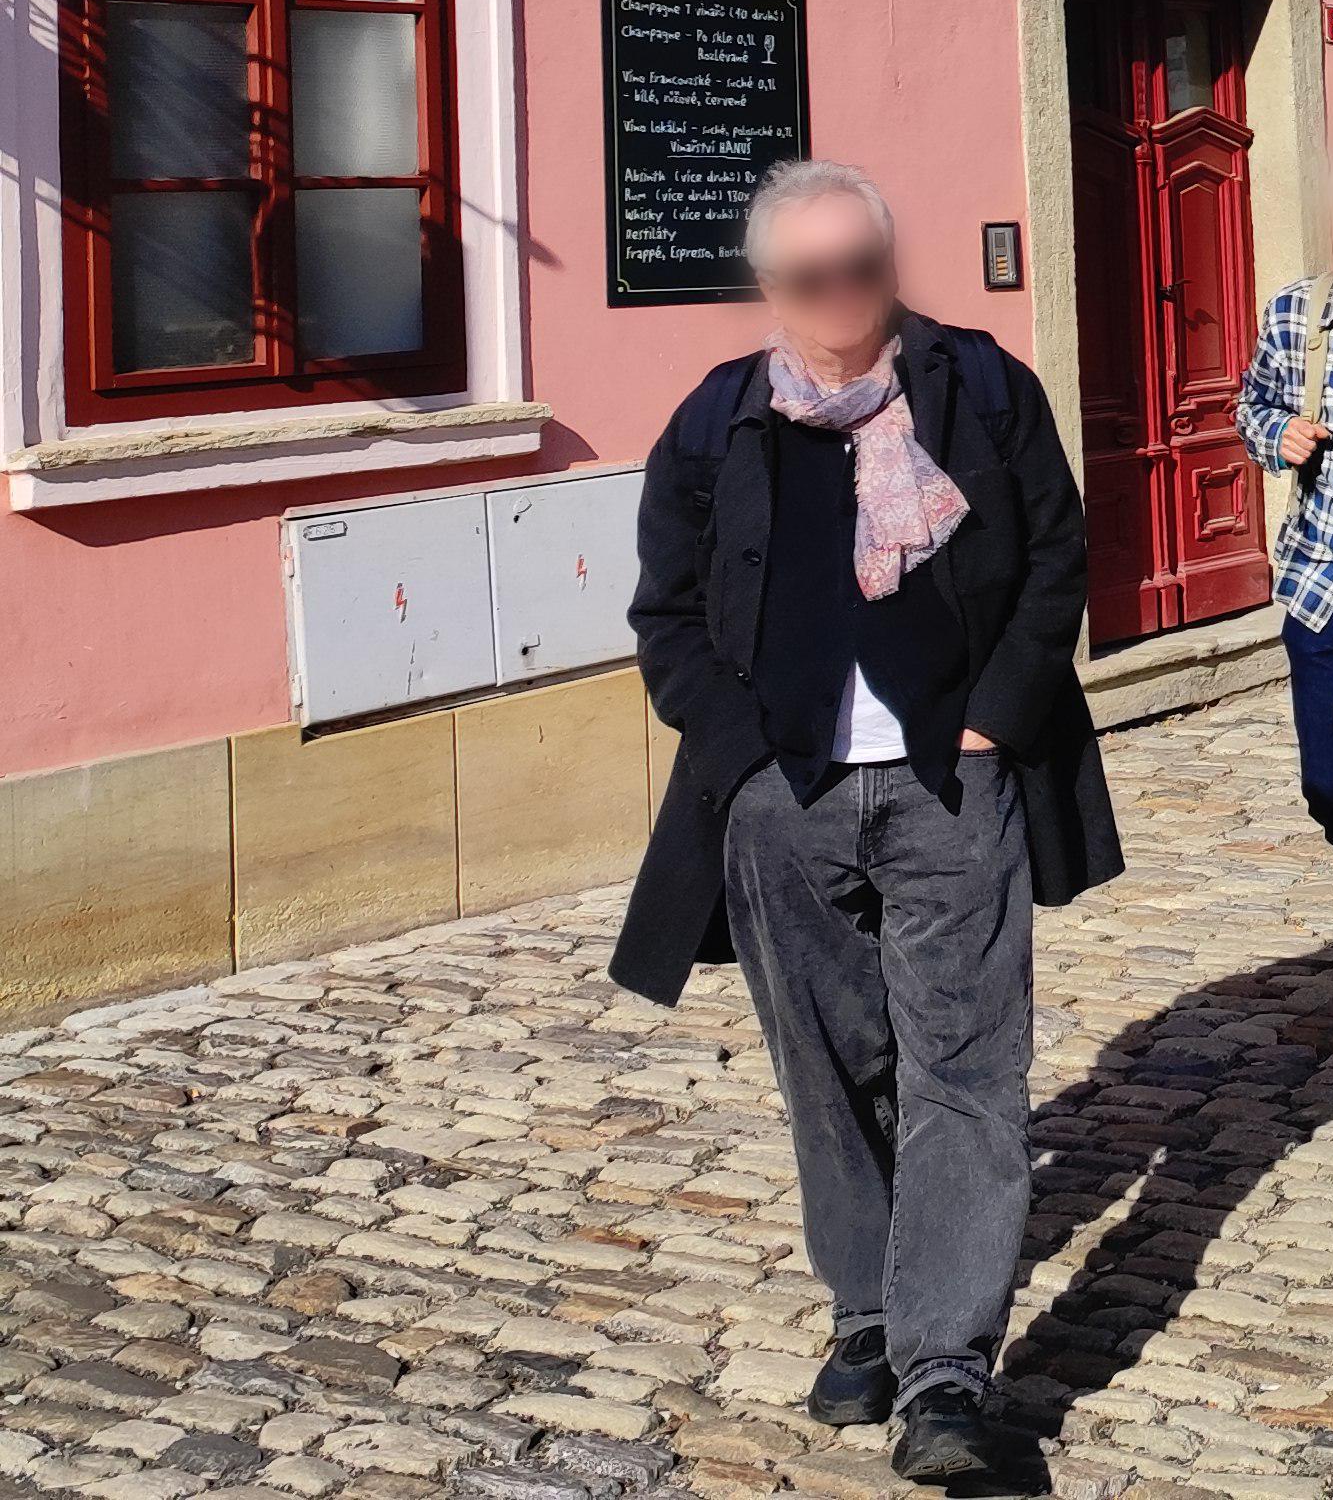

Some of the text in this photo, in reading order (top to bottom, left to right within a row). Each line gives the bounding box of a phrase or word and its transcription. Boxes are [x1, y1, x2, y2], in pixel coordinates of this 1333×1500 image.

[621, 0, 680, 17] Champagne
[621, 25, 680, 43] Champagne
[625, 207, 664, 222] Whisky
